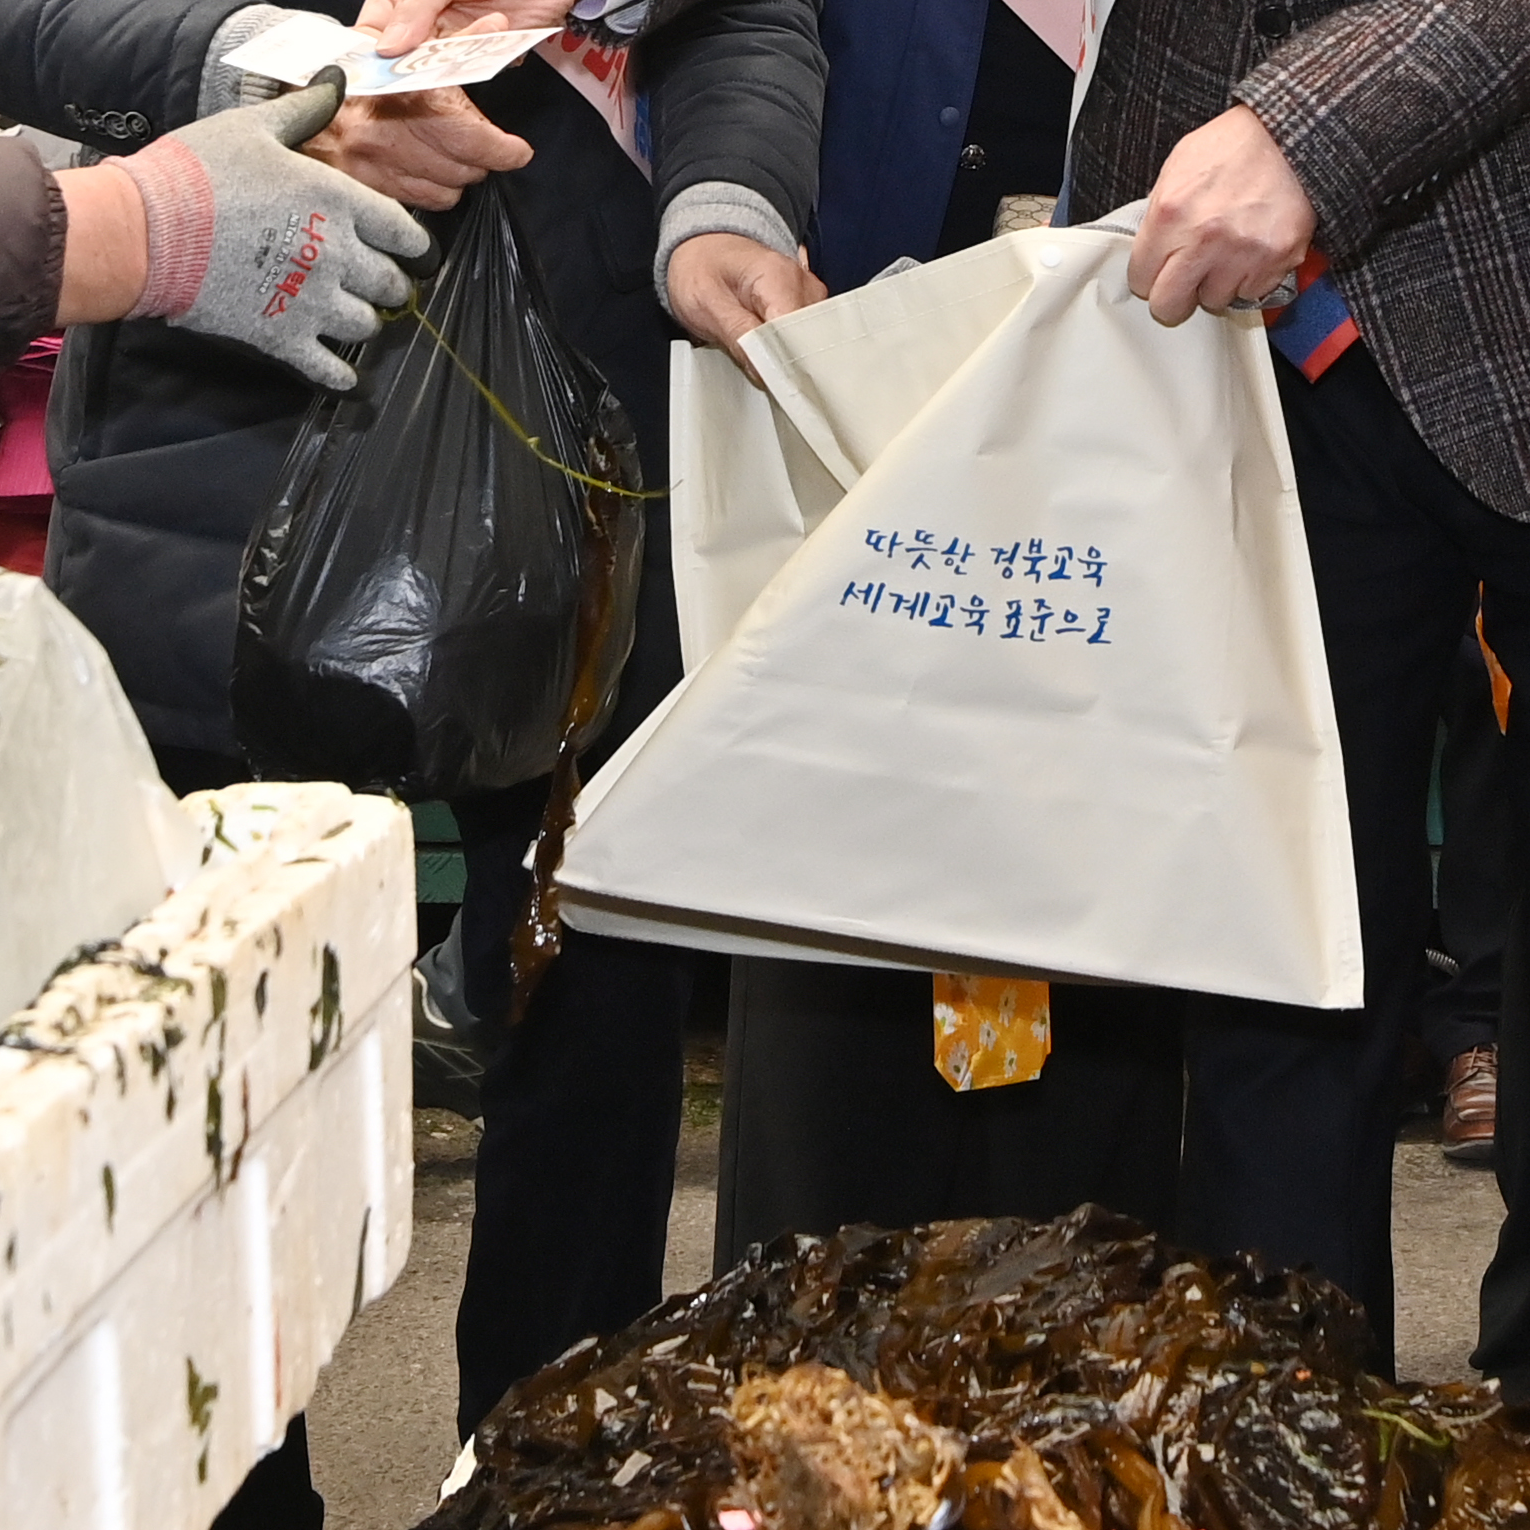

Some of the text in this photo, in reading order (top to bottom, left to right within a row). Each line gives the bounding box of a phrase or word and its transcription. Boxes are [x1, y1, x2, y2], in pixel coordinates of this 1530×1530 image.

[865, 528, 1108, 588] 따뜻한 경북교육
[839, 580, 1112, 645] 세계교육 표준으로
